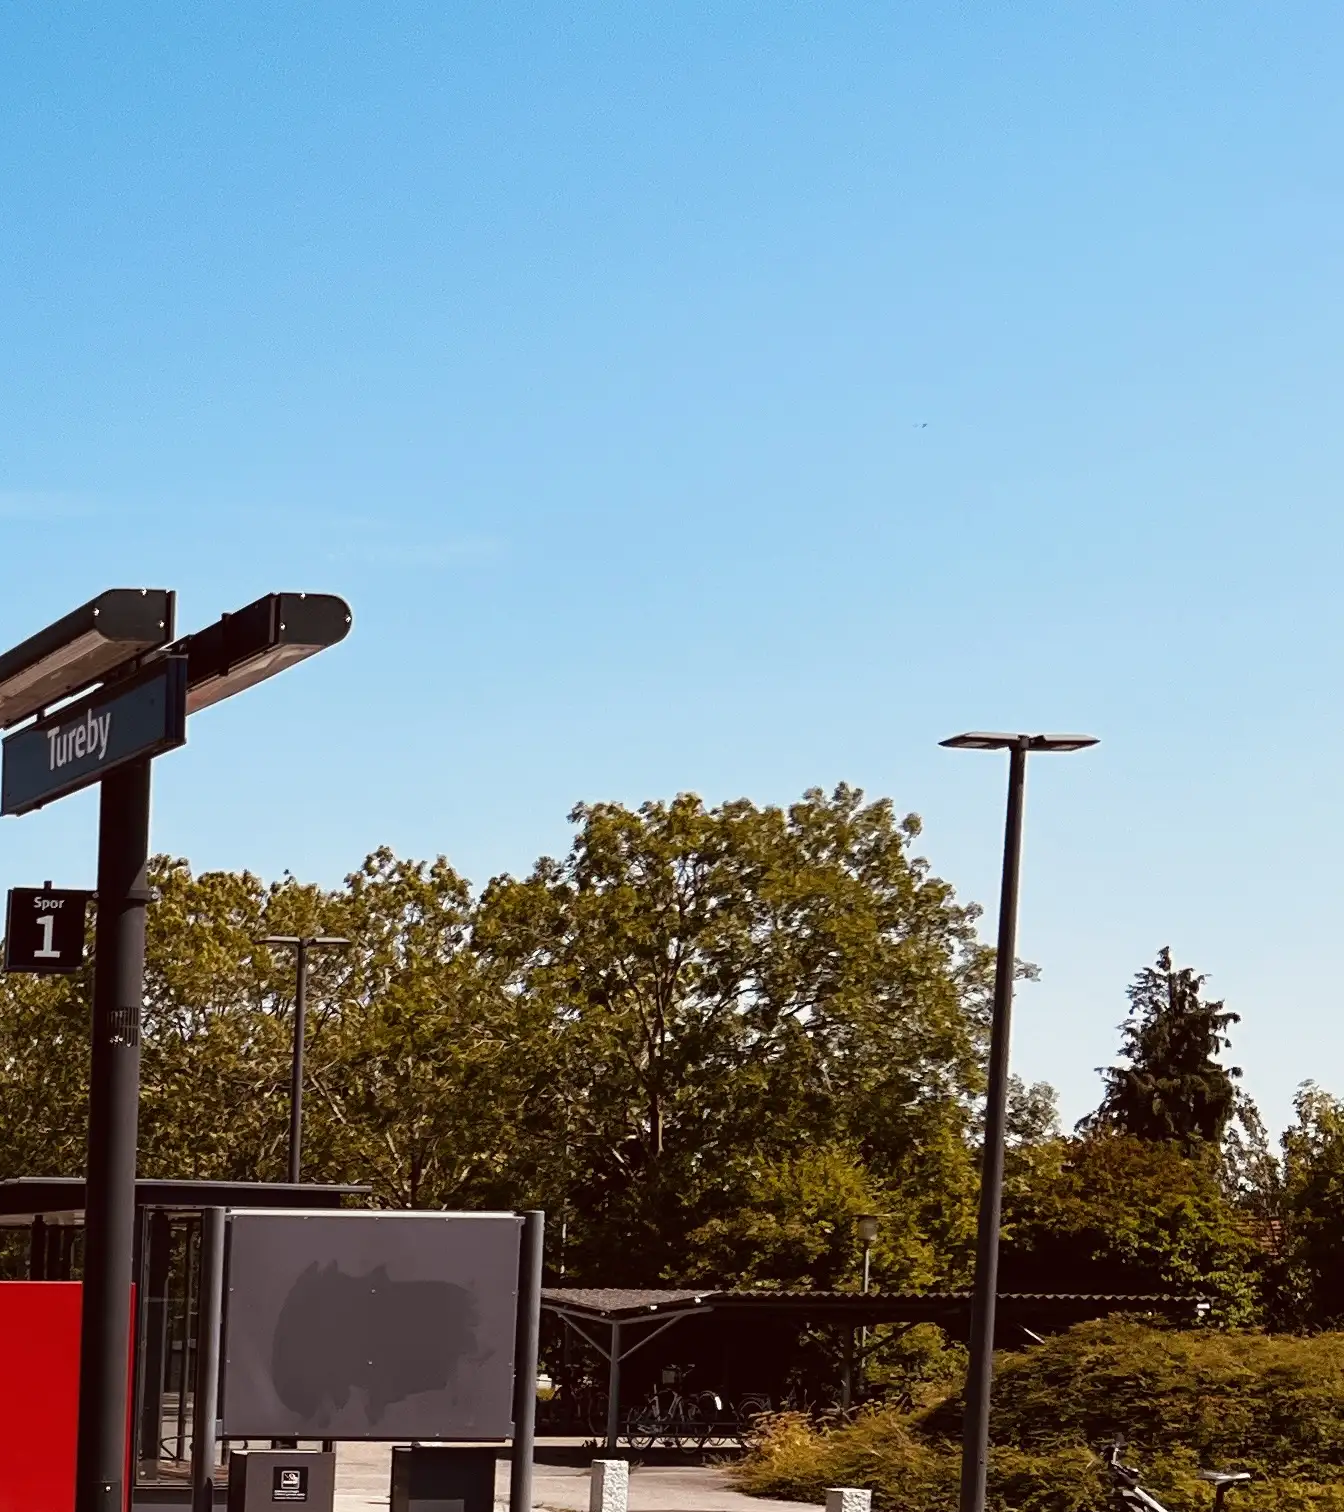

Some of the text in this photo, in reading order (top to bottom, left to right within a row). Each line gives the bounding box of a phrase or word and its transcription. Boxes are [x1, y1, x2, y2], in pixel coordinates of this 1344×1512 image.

[47, 708, 111, 771] Tureby
[33, 896, 65, 911] Spor
[33, 915, 61, 958] 1
